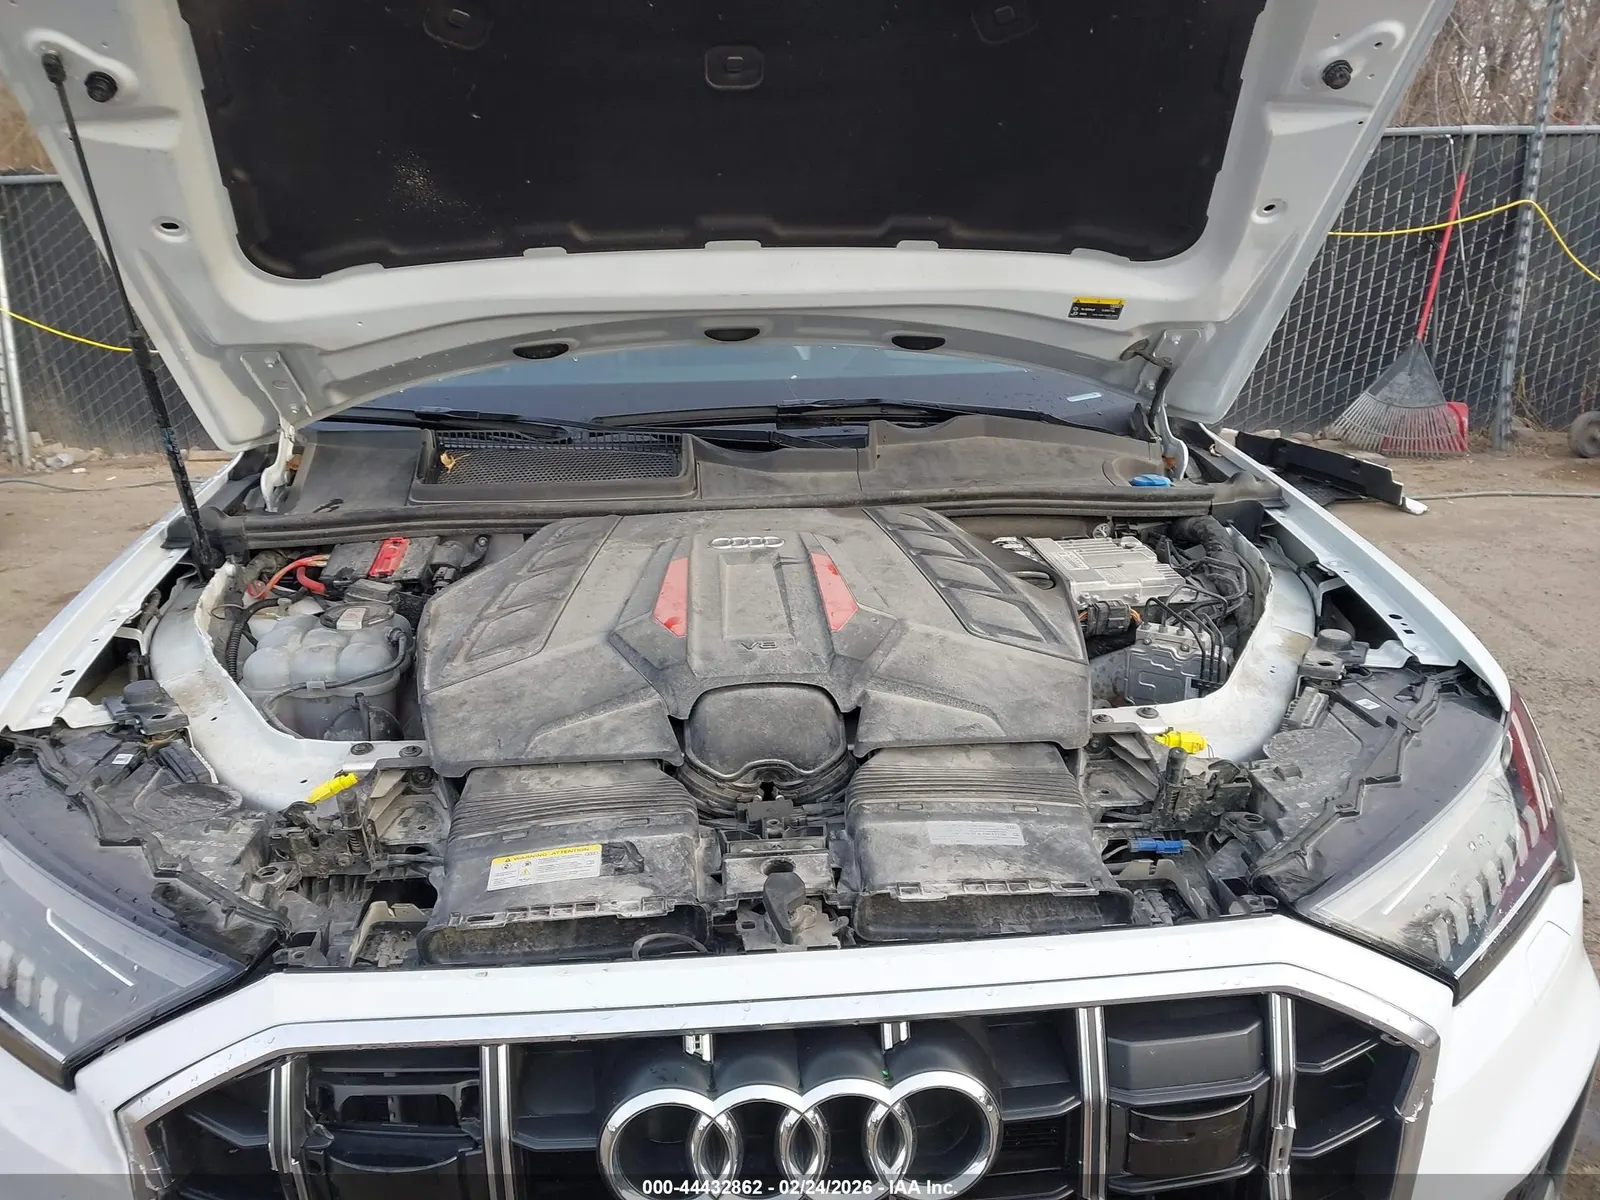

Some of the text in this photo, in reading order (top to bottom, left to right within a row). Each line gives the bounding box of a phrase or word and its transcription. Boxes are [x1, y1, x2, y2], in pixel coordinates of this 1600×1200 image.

[740, 641, 779, 651] V8
[513, 847, 590, 861] WARNING ATTENTION
